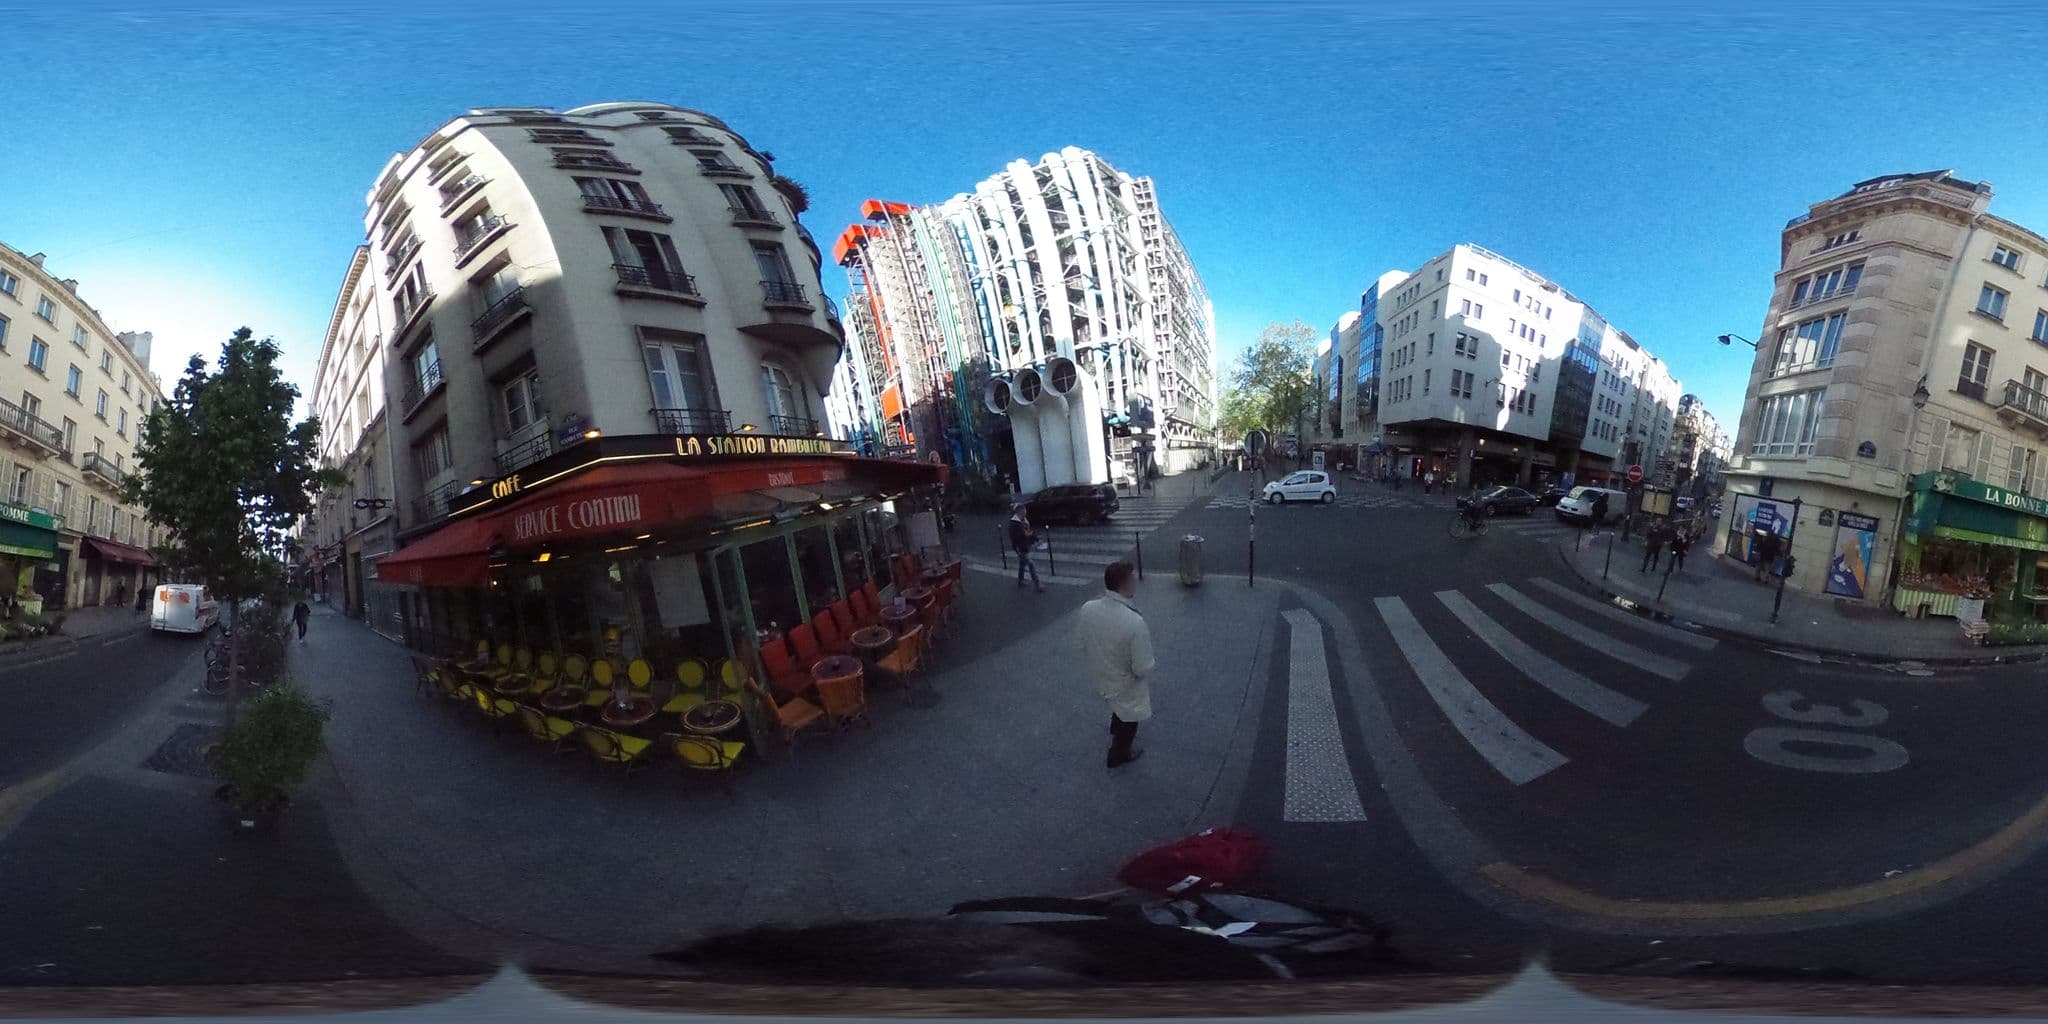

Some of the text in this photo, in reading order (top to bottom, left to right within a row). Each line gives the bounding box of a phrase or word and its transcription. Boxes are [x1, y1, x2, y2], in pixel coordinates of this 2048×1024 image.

[676, 437, 702, 456] LA
[707, 437, 766, 455] STATION
[1985, 487, 2000, 503] LA
[2005, 493, 2041, 513] BONNE
[514, 493, 641, 541] SERVICE CONTINU
